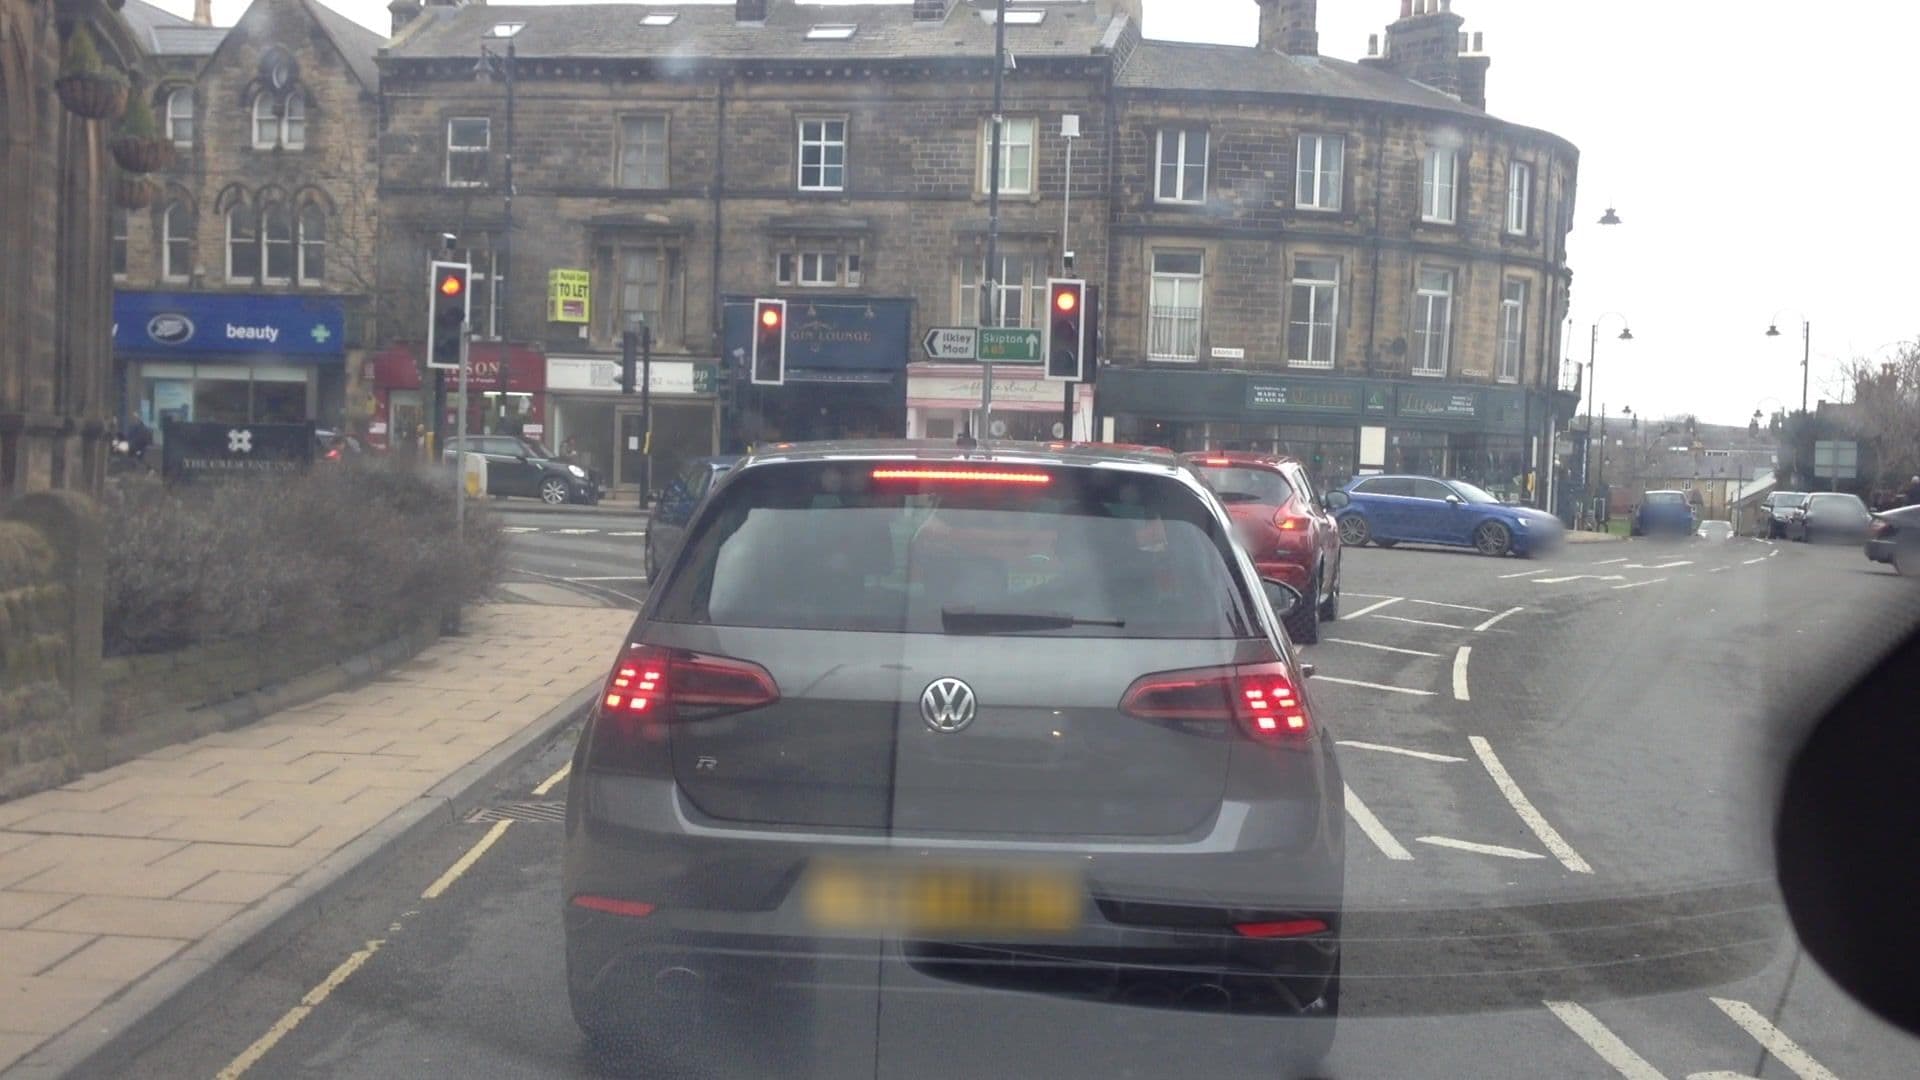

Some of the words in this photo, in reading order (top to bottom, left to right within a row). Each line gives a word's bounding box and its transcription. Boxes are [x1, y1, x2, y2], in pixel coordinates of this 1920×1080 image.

[559, 283, 571, 297] TO
[572, 283, 589, 298] LET
[226, 323, 279, 343] beauty
[818, 330, 872, 342] LOUNGE
[942, 332, 972, 345] Ilkley
[983, 331, 1024, 345] Skipton
[942, 344, 969, 354] Moor
